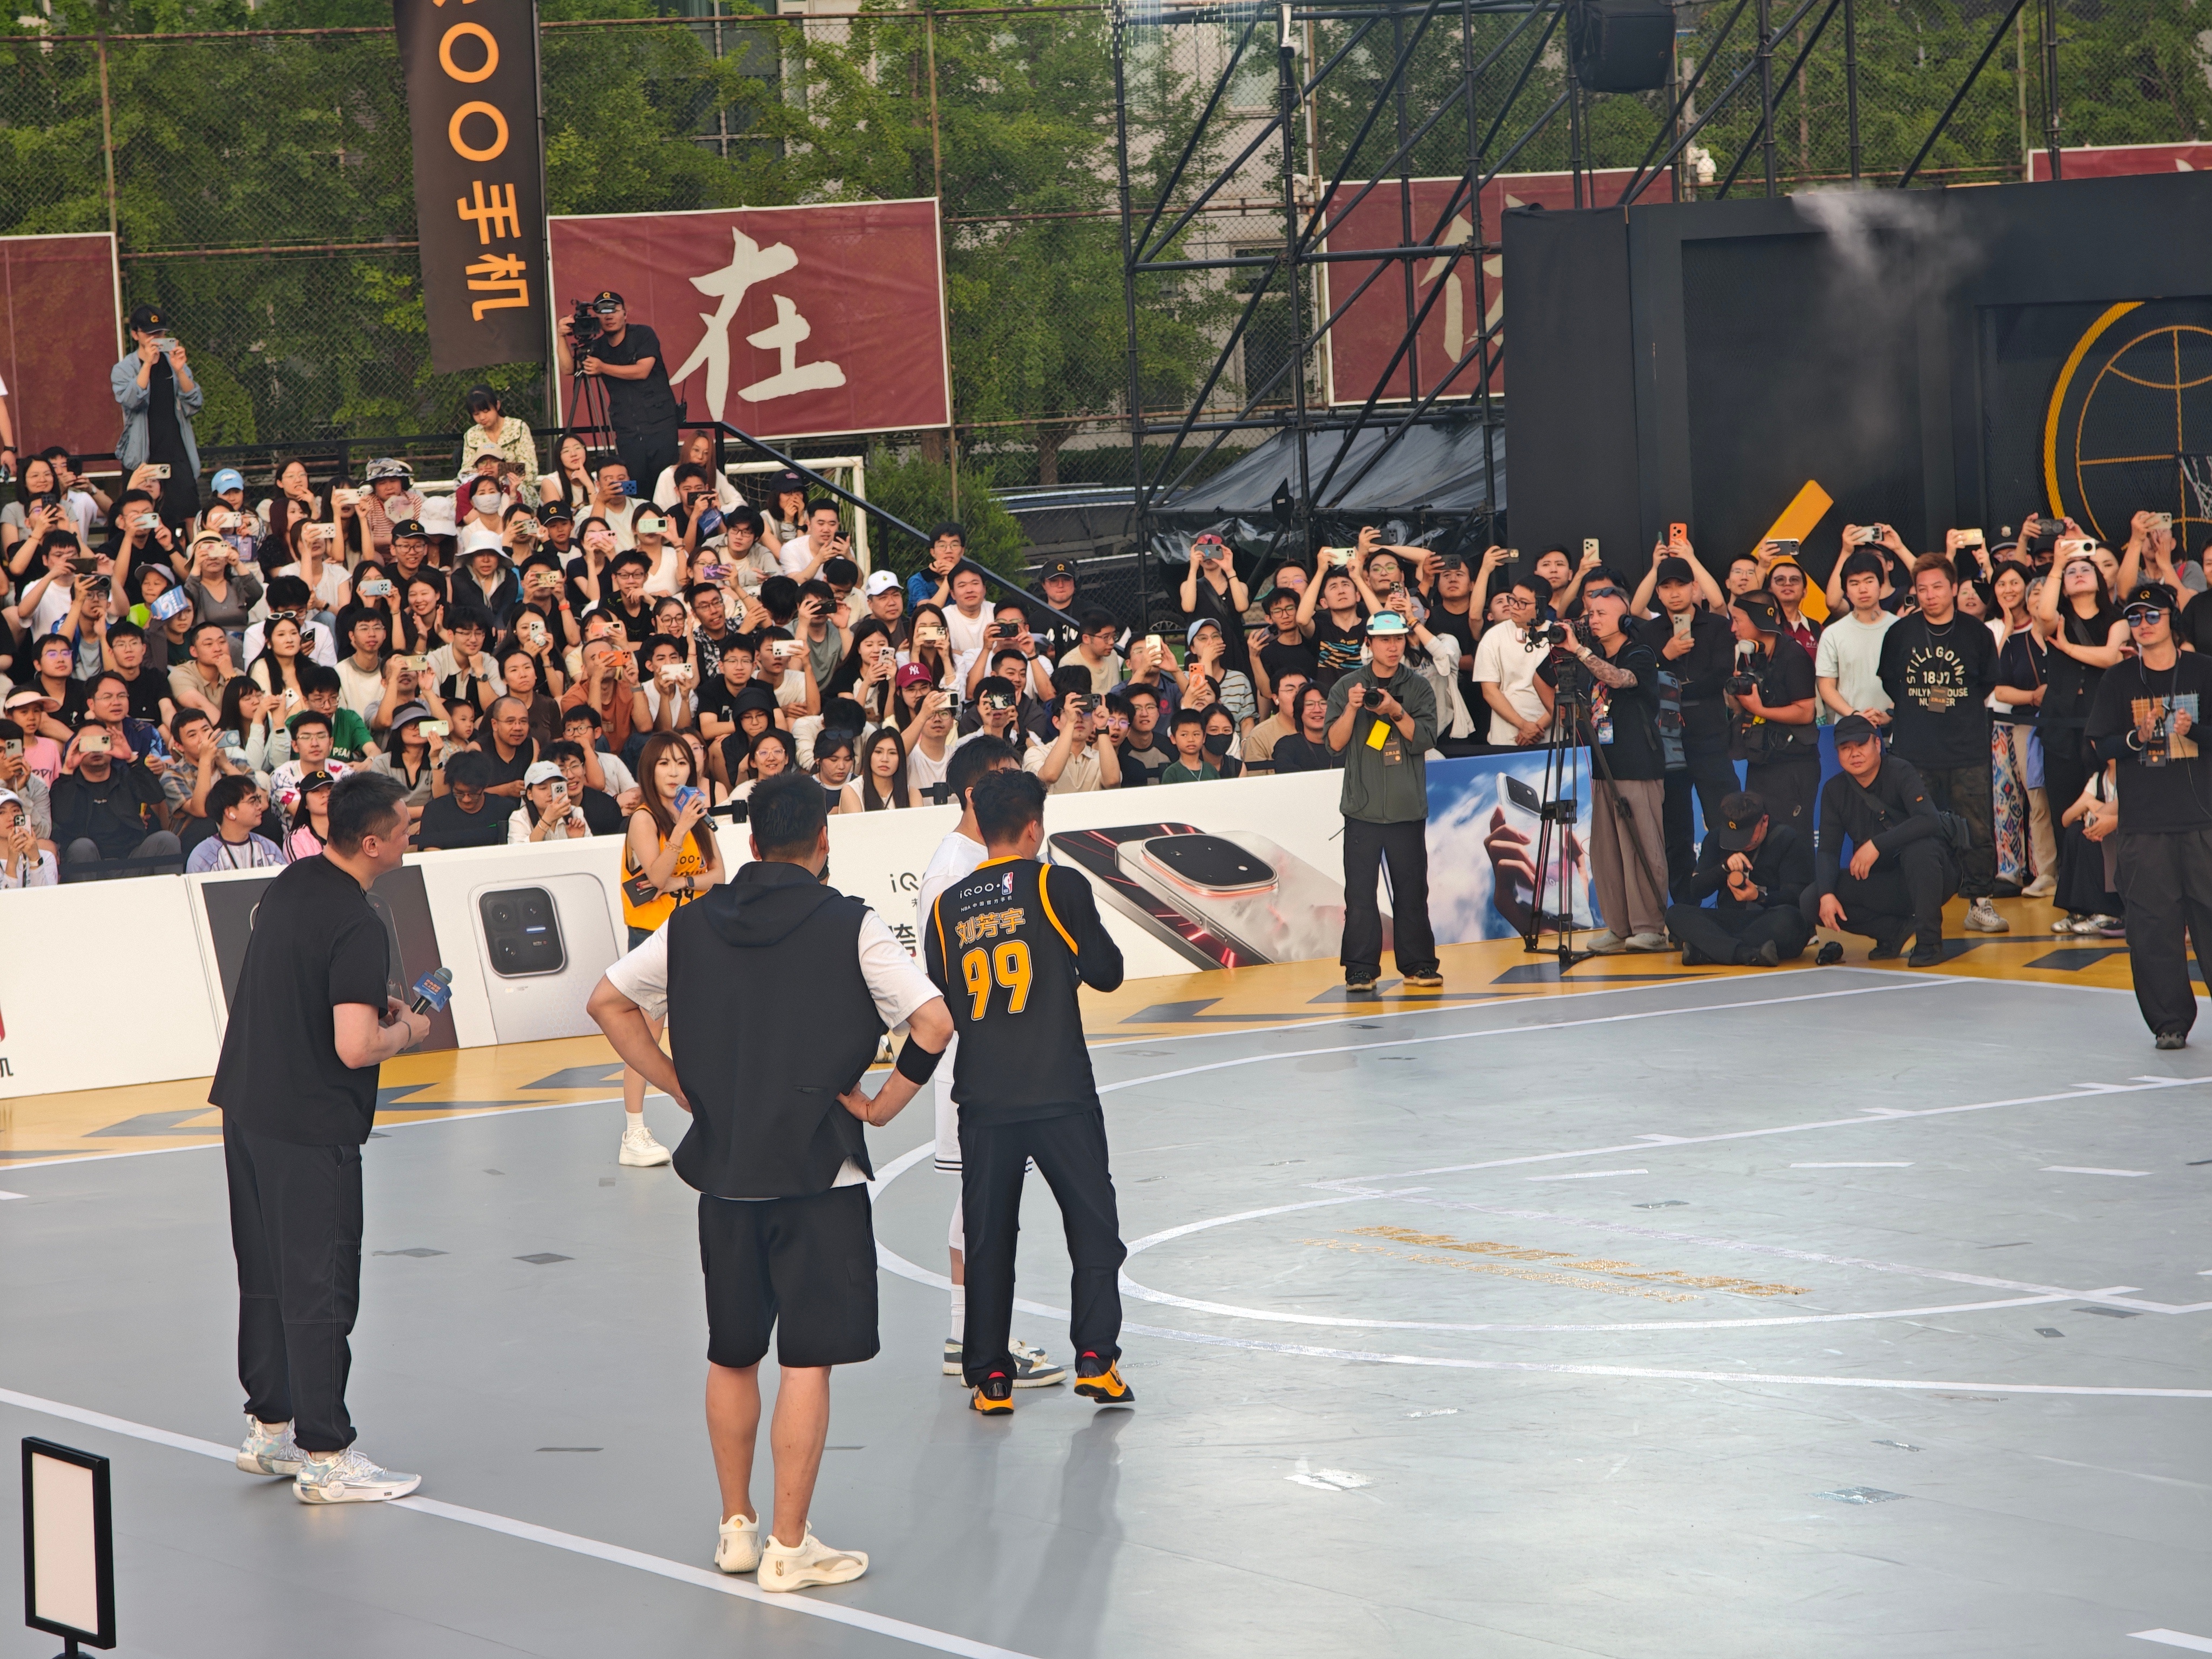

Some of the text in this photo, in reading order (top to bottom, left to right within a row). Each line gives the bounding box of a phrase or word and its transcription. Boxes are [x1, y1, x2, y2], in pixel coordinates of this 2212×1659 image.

[433, 0, 529, 321] OO手机
[669, 226, 847, 422] 在
[1906, 647, 1933, 685] STILL
[955, 908, 1026, 949] 刘芳宇
[961, 940, 1033, 1022] 99
